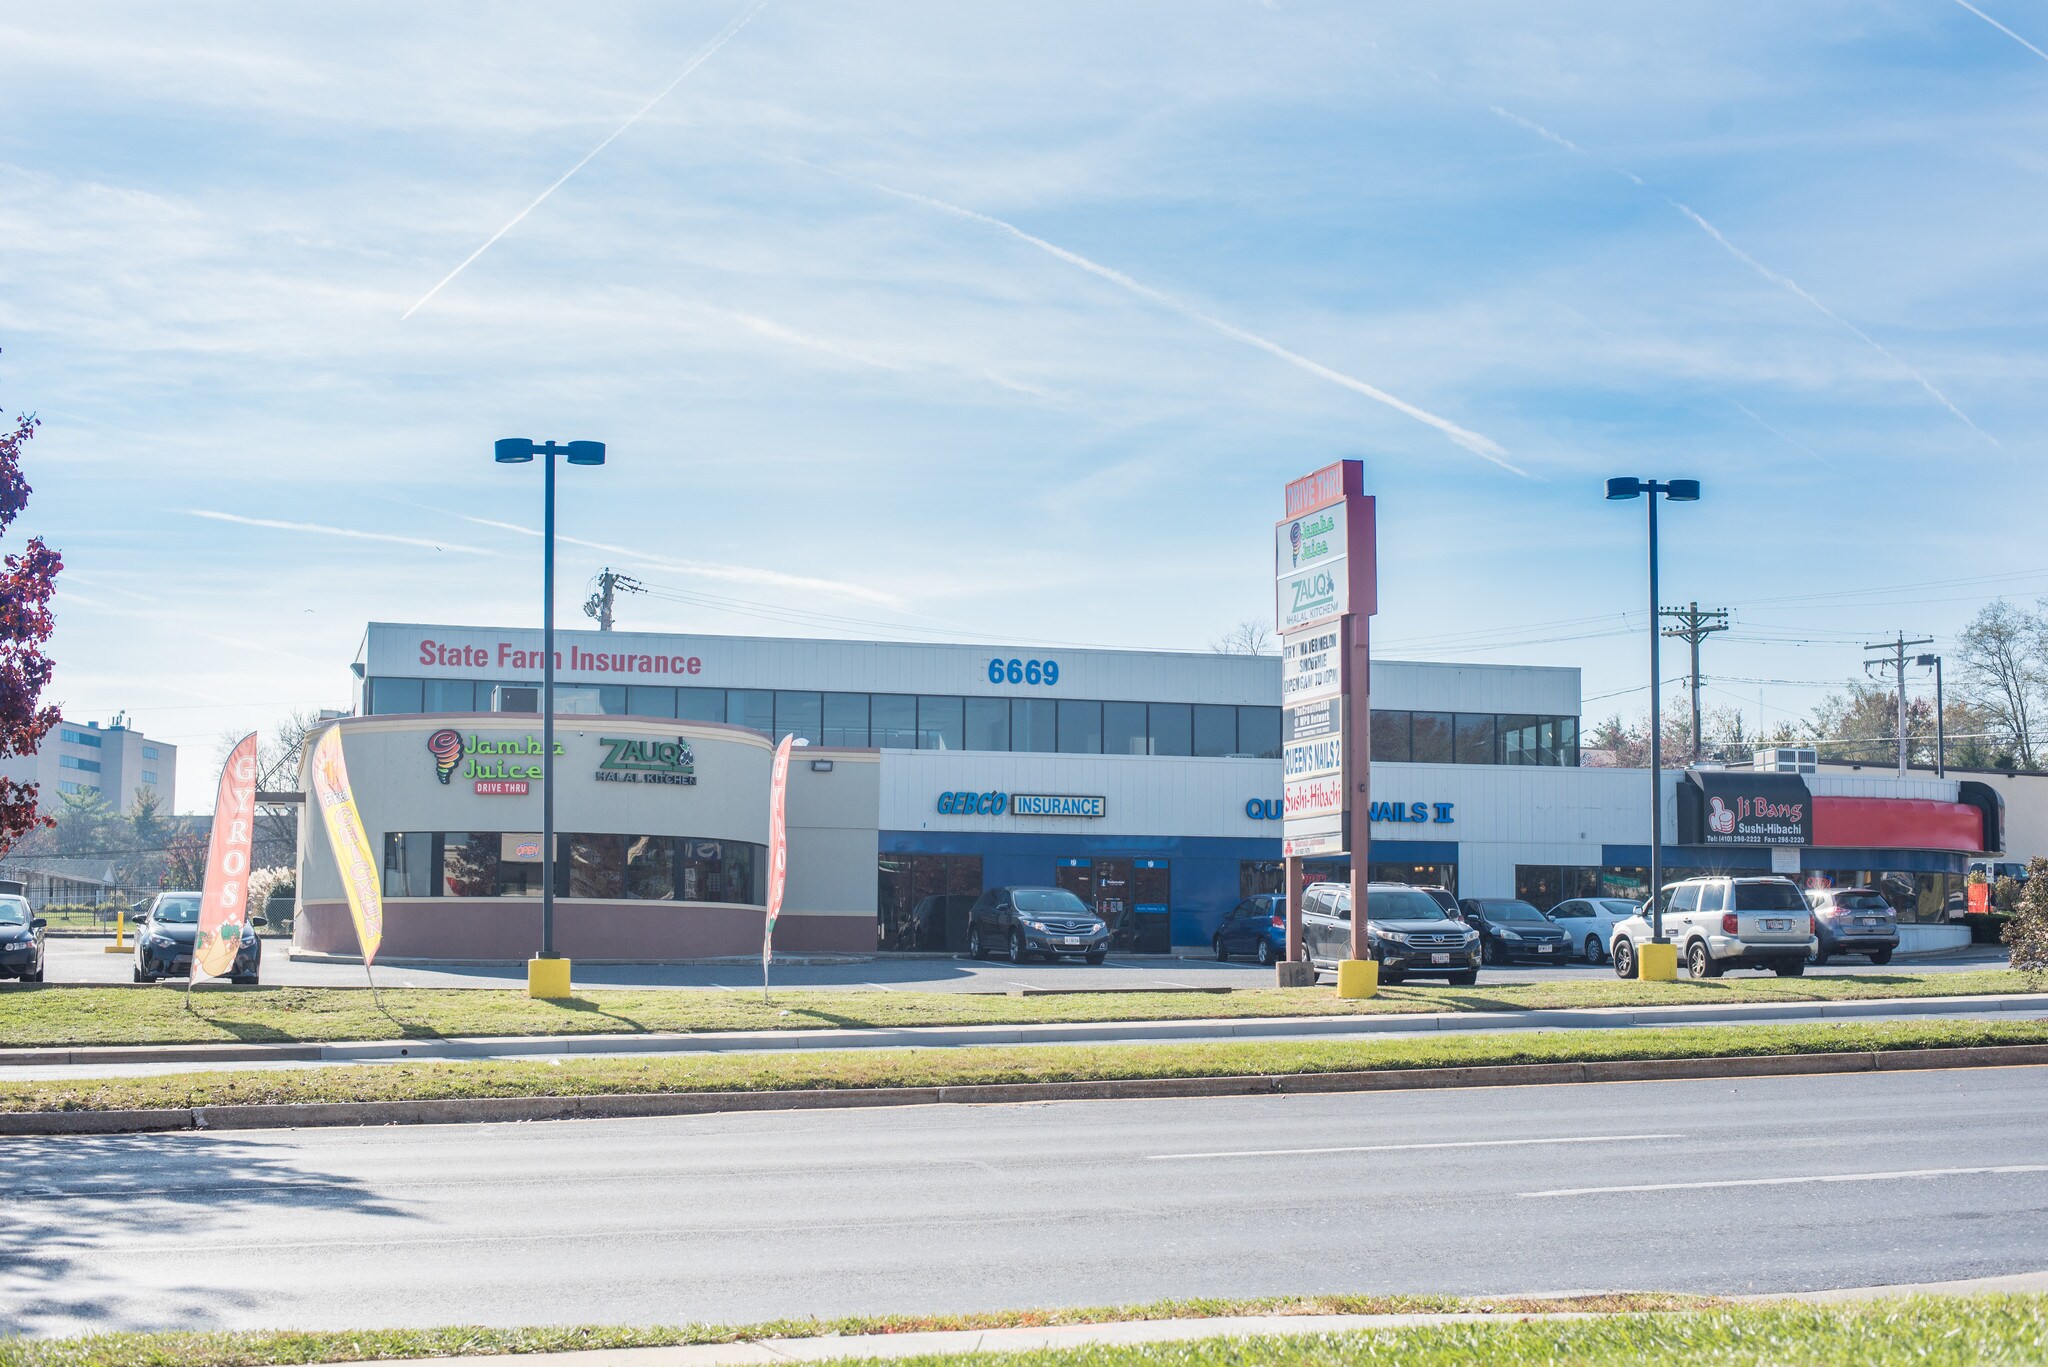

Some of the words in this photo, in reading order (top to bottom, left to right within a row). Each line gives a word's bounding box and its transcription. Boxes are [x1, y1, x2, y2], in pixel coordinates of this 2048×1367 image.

[1287, 478, 1314, 513] DRIVE
[1316, 467, 1341, 503] THRU
[1300, 515, 1334, 540] Jamba
[1301, 539, 1328, 561] Juice
[1291, 573, 1333, 613] ZAUQ
[1288, 611, 1308, 624] HALAL
[1310, 603, 1336, 619] KITCHEN
[419, 640, 488, 668] State
[571, 645, 702, 675] Insurance
[1284, 645, 1296, 660] TRY
[988, 658, 1059, 686] 6669
[464, 734, 566, 755] Jamba
[600, 737, 695, 774] ZAUQ
[463, 758, 544, 779] Juice
[1286, 745, 1313, 775] QUEEN'S
[1314, 741, 1335, 770] NAILS
[1336, 740, 1340, 767] 2
[477, 782, 502, 793] DRIVE
[505, 783, 527, 794] THRU
[599, 771, 643, 784] HALAL
[646, 774, 693, 786] KITCHEN
[937, 791, 1008, 816] GEBCO
[1018, 797, 1100, 815] INSURANCE
[1285, 780, 1341, 813] Sushi-Hibachi
[1737, 796, 1750, 822] Ji
[1753, 796, 1803, 822] Bang
[221, 756, 255, 909] GYROS
[1718, 835, 1733, 843] (410)
[1738, 823, 1802, 835] Sushi-Hibachi
[516, 845, 538, 855] OPEN
[335, 806, 383, 939] CHICKEN
